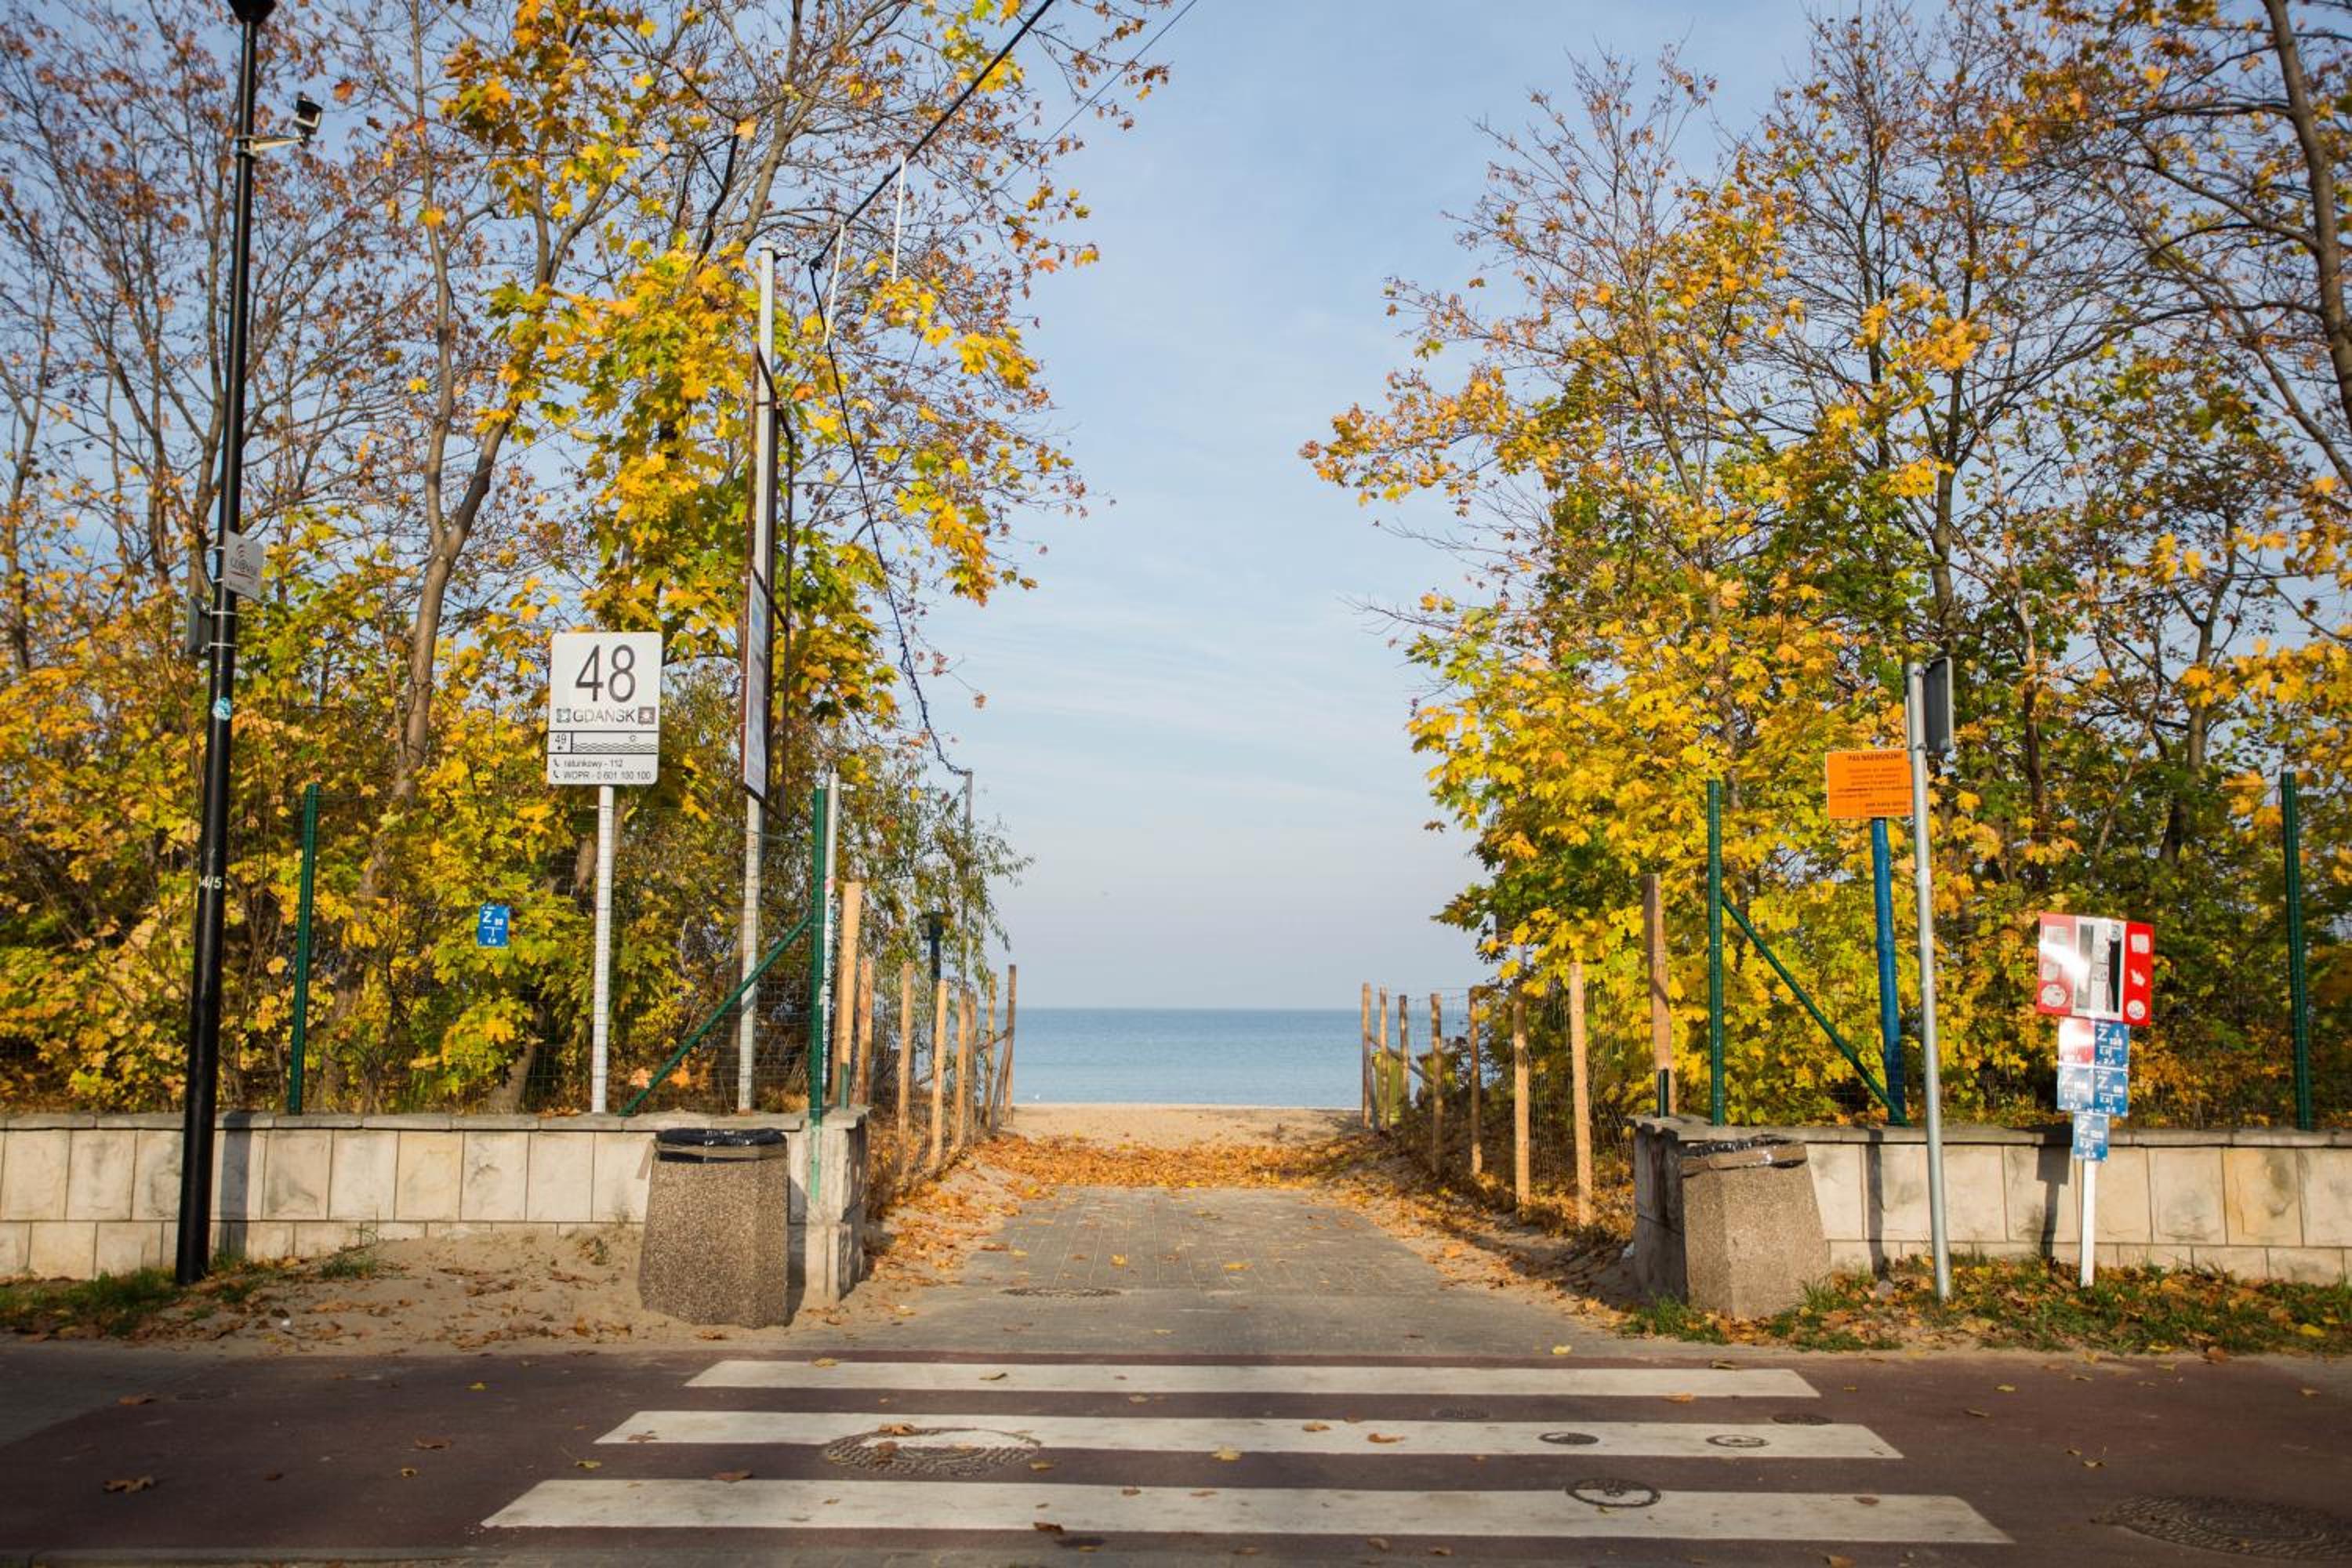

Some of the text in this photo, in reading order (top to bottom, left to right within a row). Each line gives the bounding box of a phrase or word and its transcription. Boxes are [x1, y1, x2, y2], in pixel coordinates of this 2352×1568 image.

[575, 644, 636, 702] 48
[482, 911, 492, 923] Z
[2097, 1029, 2107, 1041] Z
